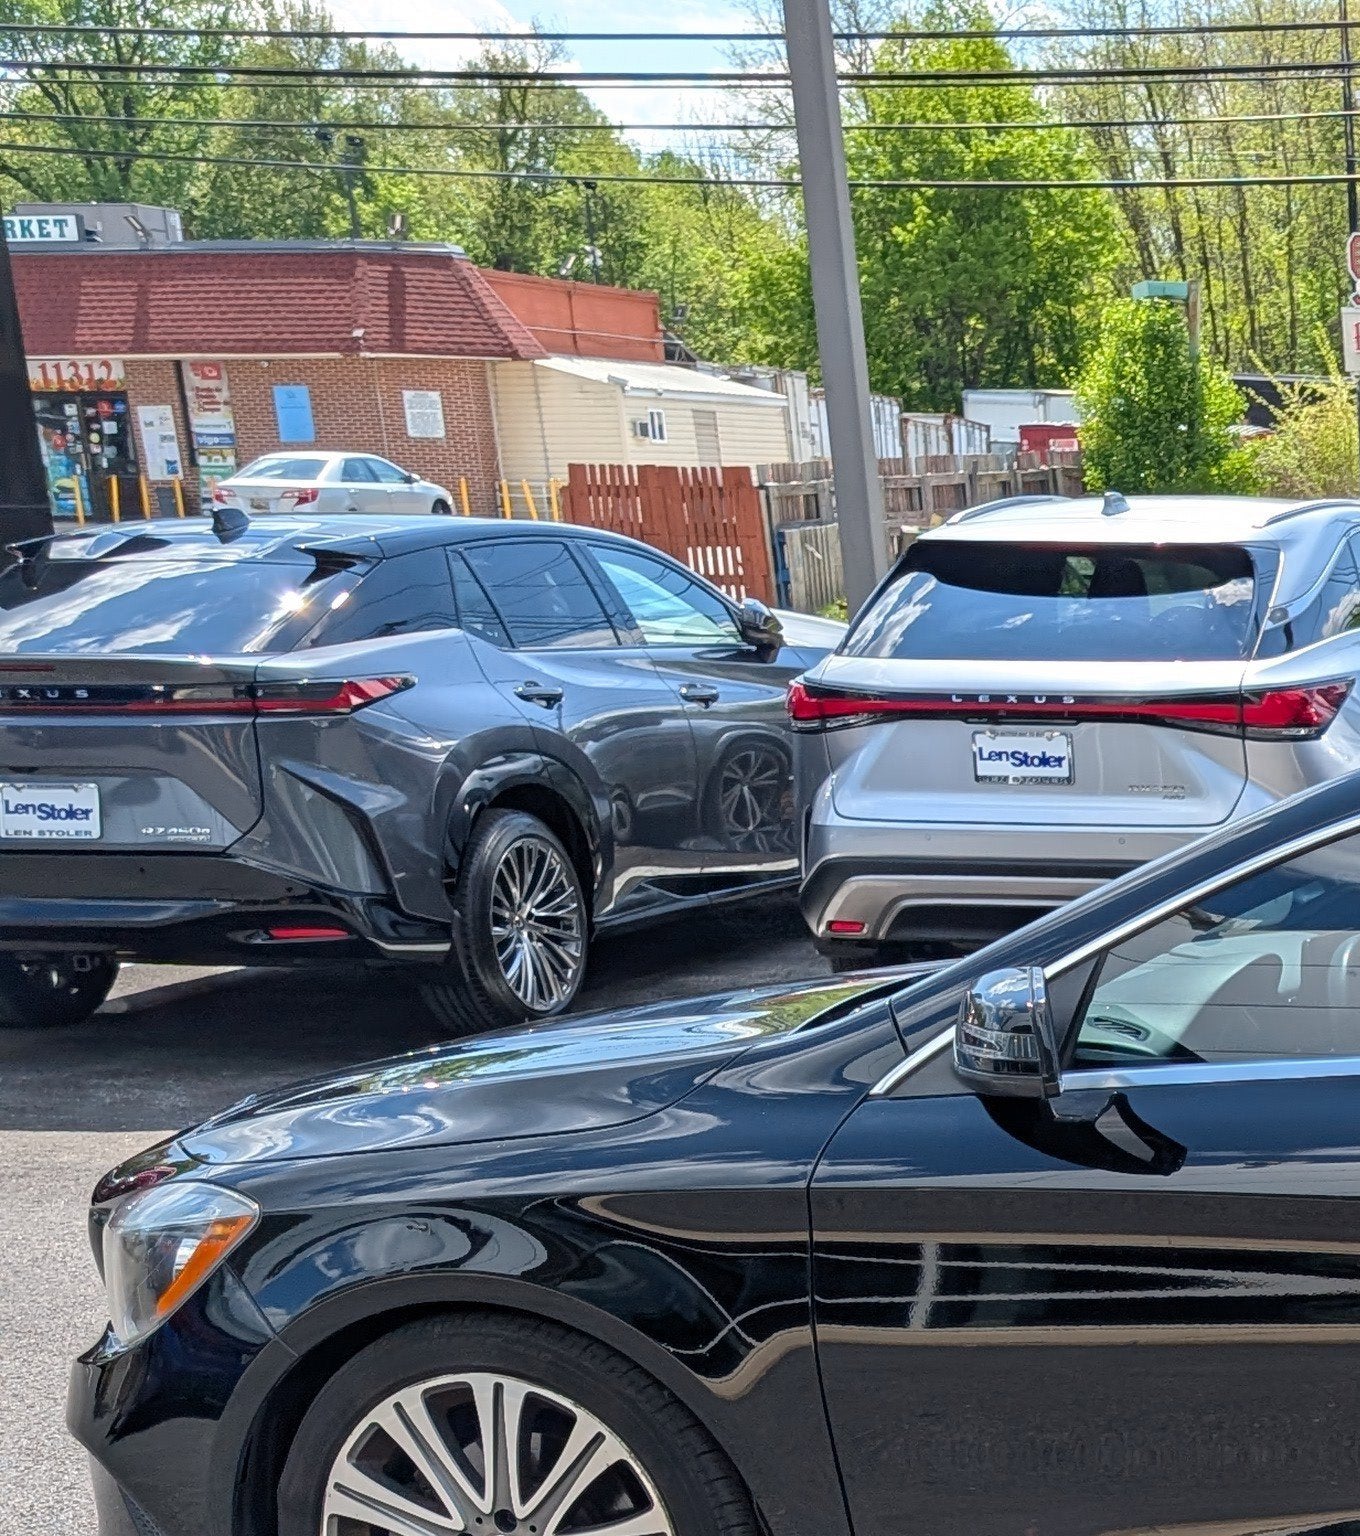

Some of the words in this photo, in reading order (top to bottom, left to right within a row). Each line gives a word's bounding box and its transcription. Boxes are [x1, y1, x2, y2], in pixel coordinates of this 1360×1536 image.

[38, 360, 117, 390] 11312
[0, 689, 89, 699] XUS
[951, 694, 1075, 704] LEXUS
[5, 829, 33, 837] LEN
[38, 829, 93, 837] STOLER
